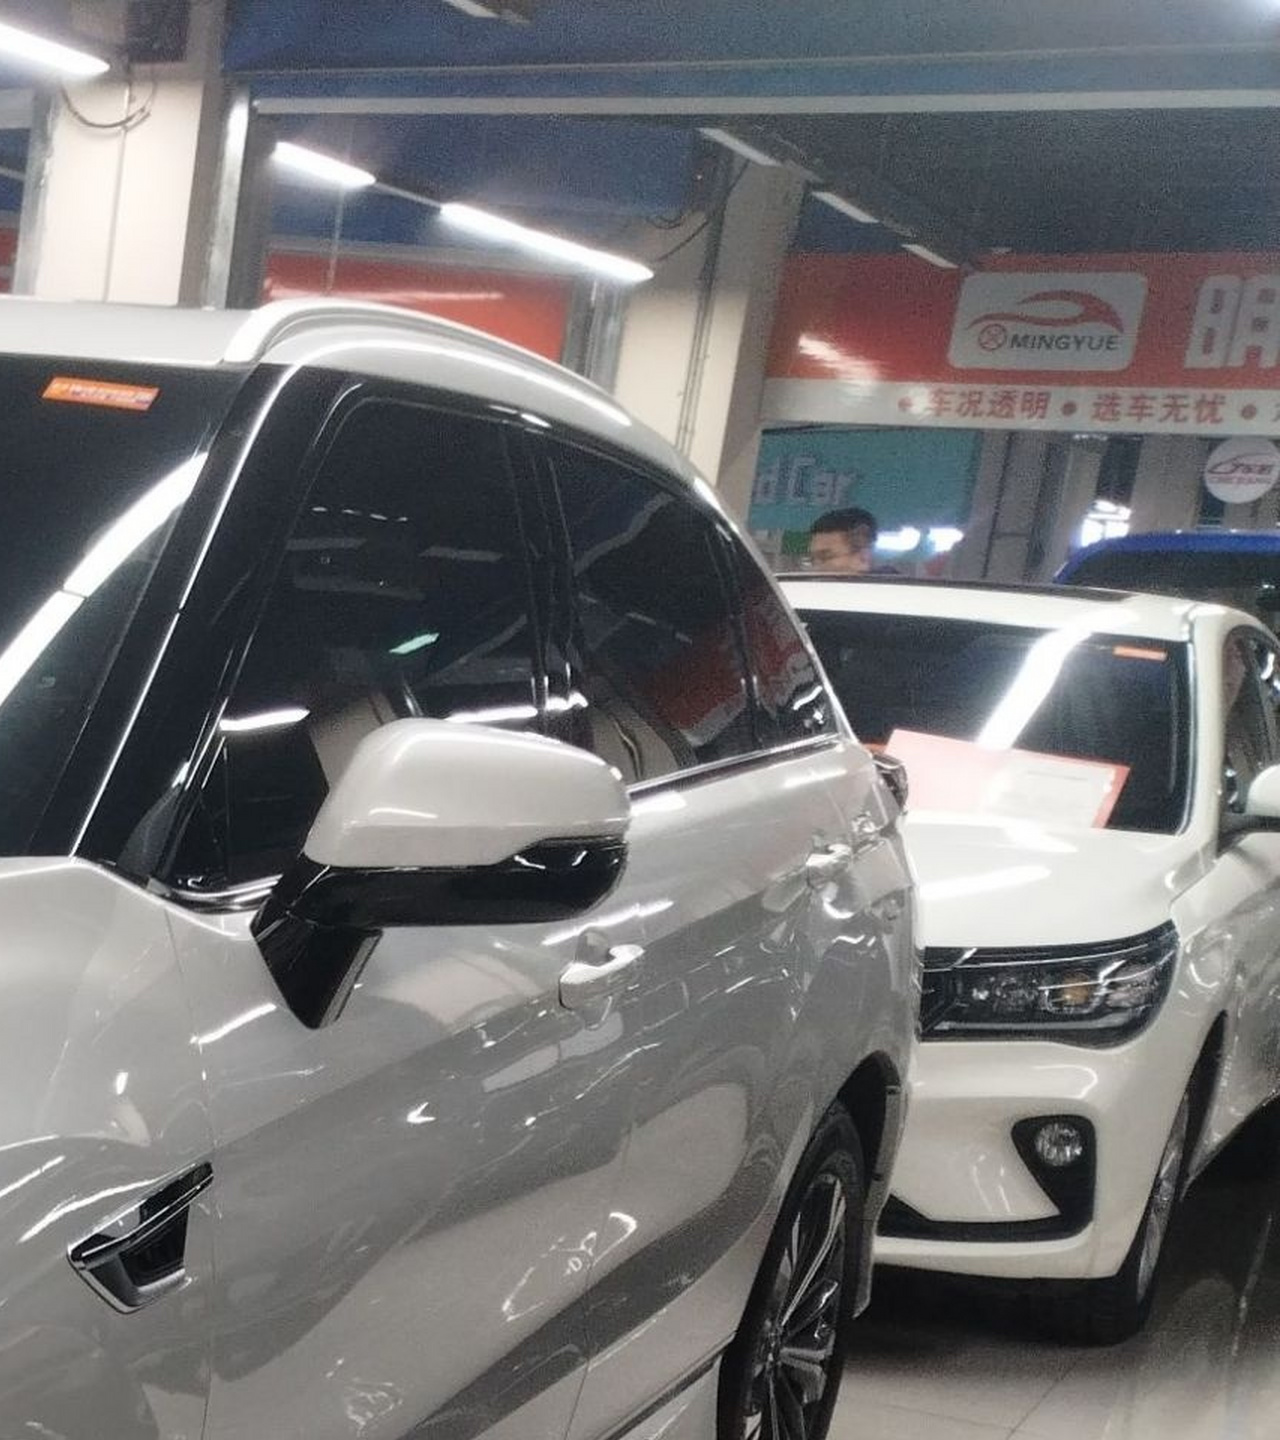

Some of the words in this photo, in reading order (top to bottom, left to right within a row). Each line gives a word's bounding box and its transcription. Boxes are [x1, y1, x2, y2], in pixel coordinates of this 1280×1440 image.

[1009, 333, 1119, 351] MINGYUE
[927, 388, 1052, 420] 车况透明
[1091, 393, 1226, 424] 选车无忧
[787, 457, 858, 506] Car
